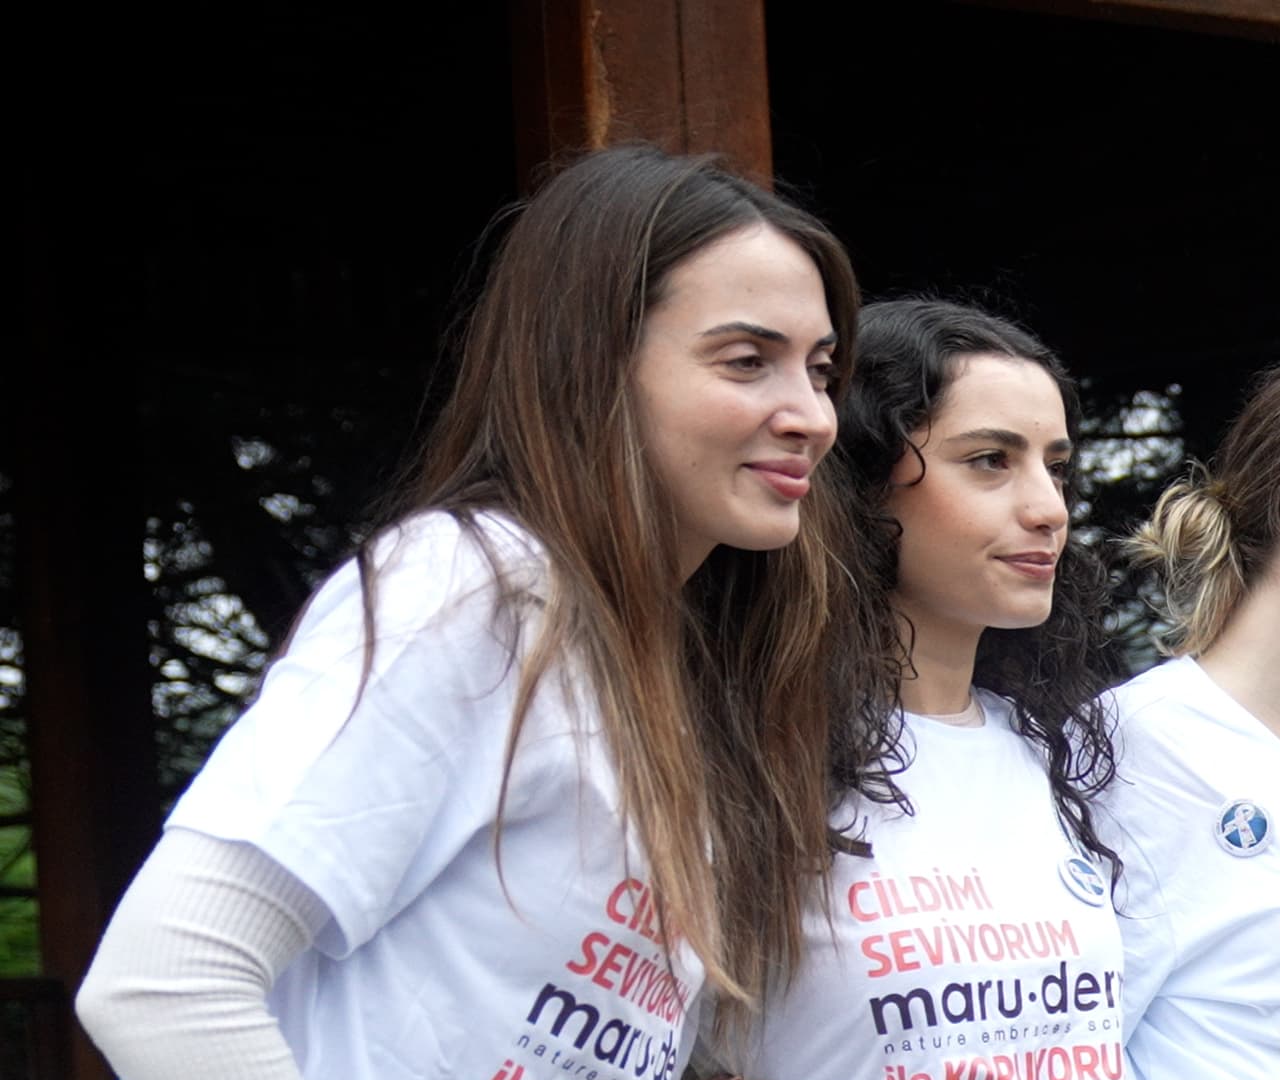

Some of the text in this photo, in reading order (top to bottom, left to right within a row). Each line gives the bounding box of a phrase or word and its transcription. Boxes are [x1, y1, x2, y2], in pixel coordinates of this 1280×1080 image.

[848, 866, 993, 923] CİLDİMİ
[861, 918, 1080, 979] SEVİYORUM
[884, 1031, 967, 1055] nature
